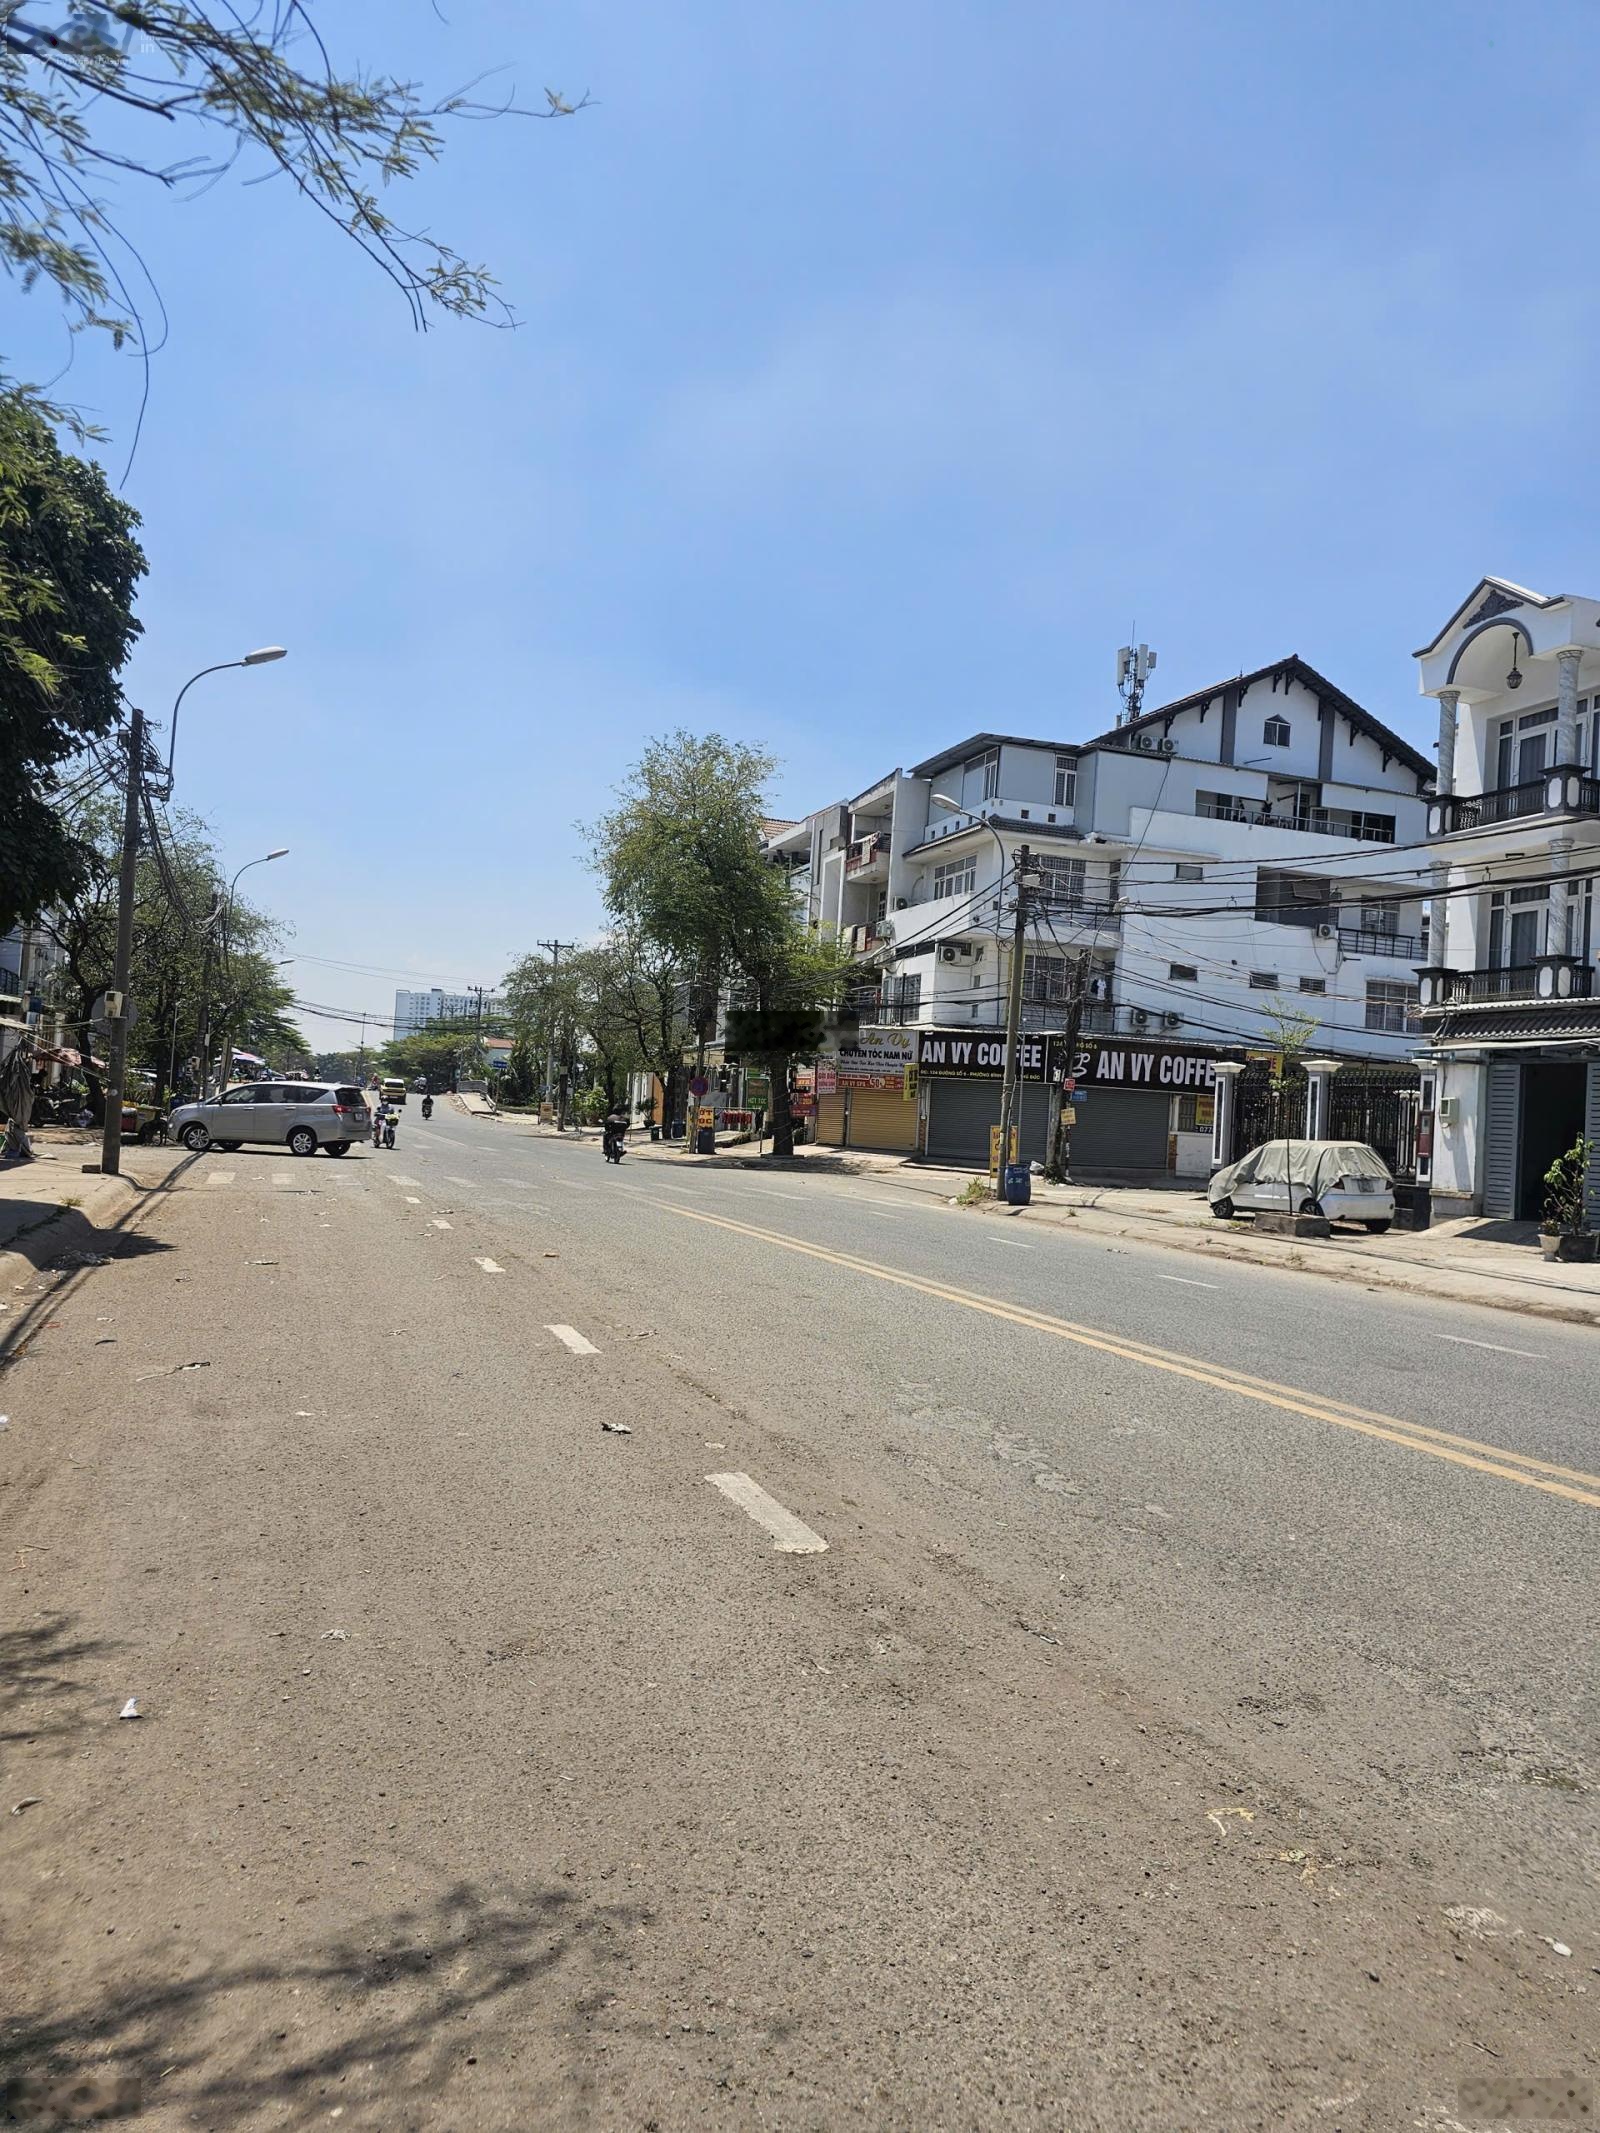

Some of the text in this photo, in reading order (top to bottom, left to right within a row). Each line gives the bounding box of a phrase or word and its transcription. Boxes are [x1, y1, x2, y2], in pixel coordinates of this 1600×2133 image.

[868, 1048, 882, 1059] TÓC
[884, 1050, 900, 1060] NAM
[921, 1041, 946, 1063] AN
[951, 1042, 972, 1065] VY
[1096, 1050, 1125, 1080] AN
[1131, 1052, 1154, 1082] VY
